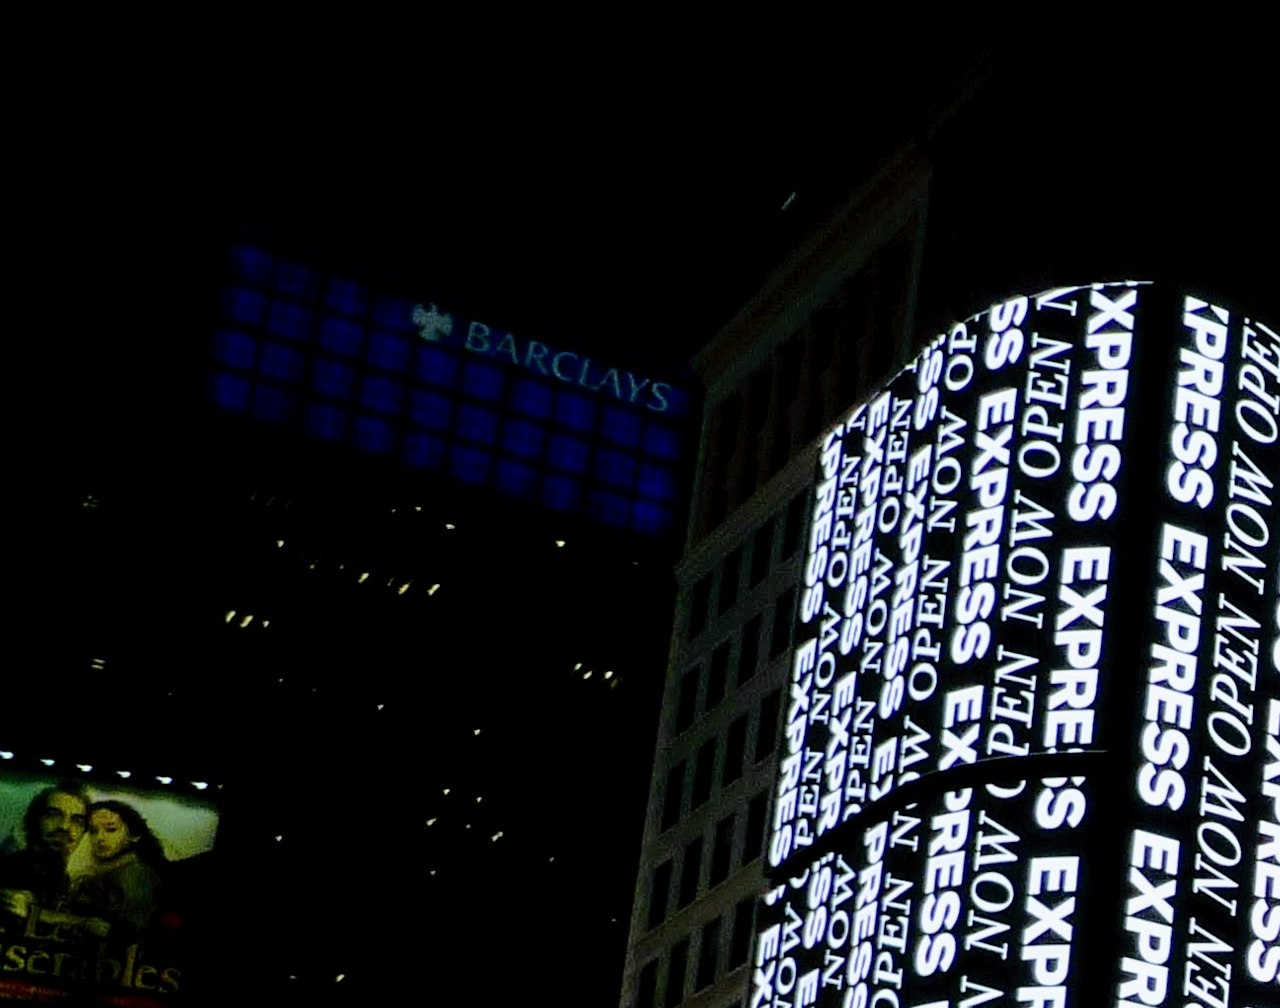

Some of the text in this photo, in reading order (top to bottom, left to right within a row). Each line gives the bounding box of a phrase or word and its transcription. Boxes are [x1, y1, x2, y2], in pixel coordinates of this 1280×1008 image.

[465, 320, 671, 412] BARCLAYS
[914, 334, 946, 431] SS
[1017, 331, 1075, 479] OPEN
[827, 454, 862, 589] OPEN
[840, 390, 892, 656] EXPRESS
[860, 547, 894, 674] NOW
[878, 396, 914, 534] OPEN
[928, 405, 968, 534] NOW
[951, 387, 1018, 665] EXPRESS
[1220, 440, 1275, 596] NOW
[880, 443, 933, 721] EXPRESS
[908, 554, 952, 702] OPEN
[1001, 489, 1056, 630] NOW
[779, 601, 813, 706] NOW
[1136, 522, 1209, 812] EXPRESS
[1208, 592, 1263, 757] OPEN
[794, 747, 824, 850] PEN
[1193, 755, 1248, 917] NOW
[822, 853, 857, 991] NOW
[964, 809, 1022, 961] NOW
